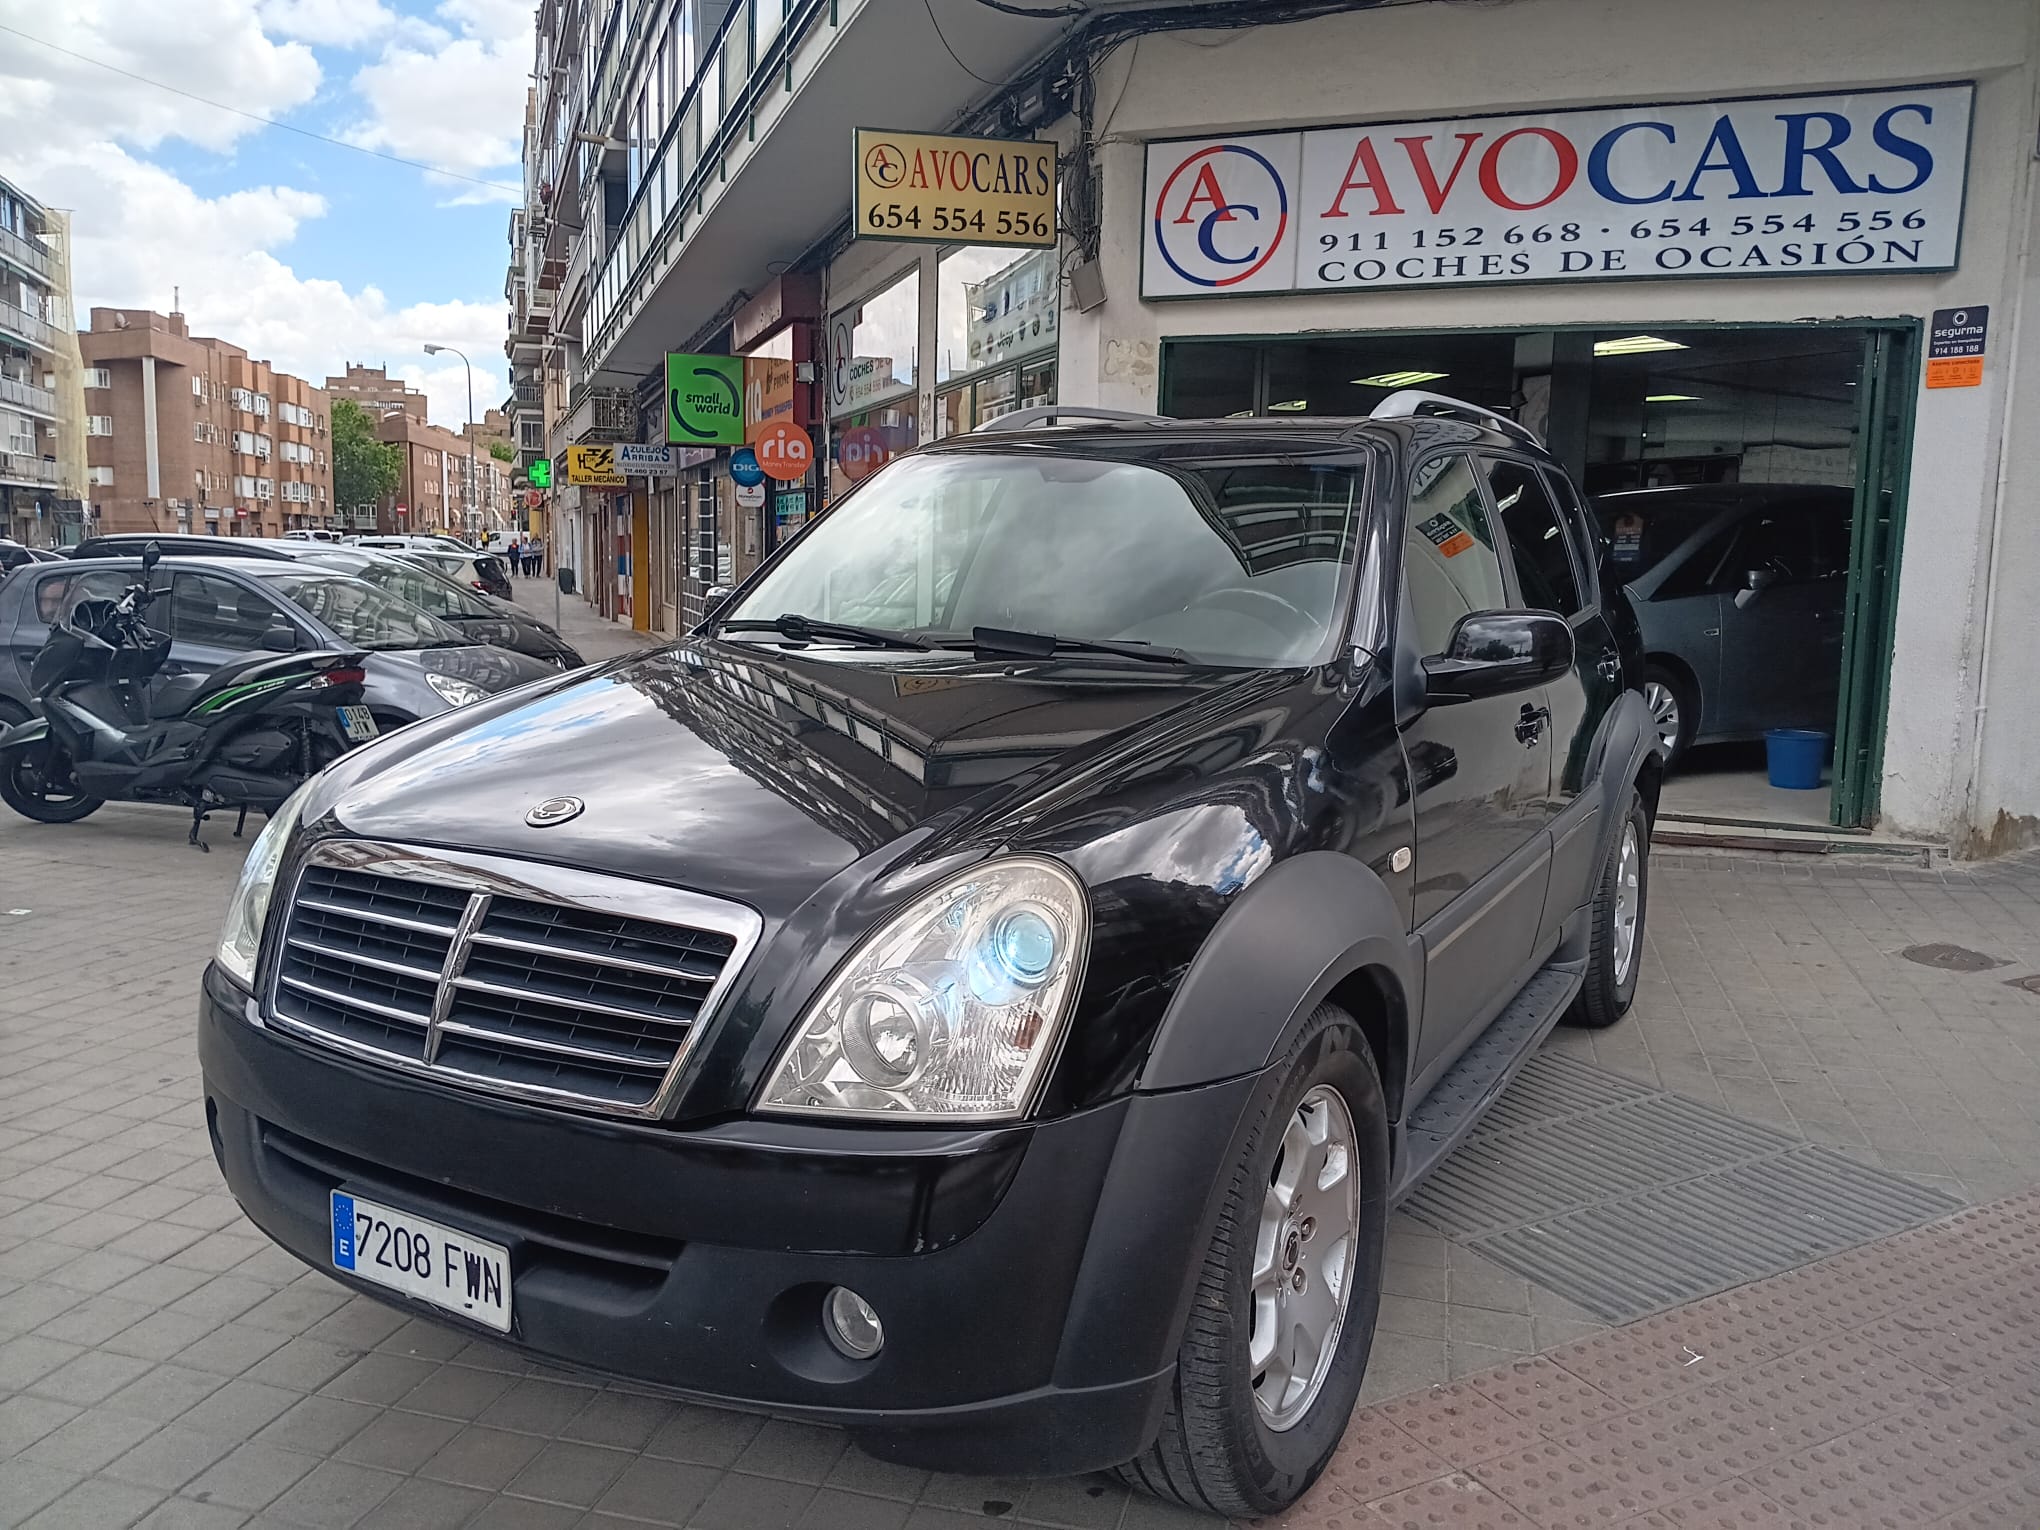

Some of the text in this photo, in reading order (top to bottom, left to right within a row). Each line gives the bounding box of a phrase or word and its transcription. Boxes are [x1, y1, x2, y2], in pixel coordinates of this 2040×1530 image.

[909, 147, 1049, 196] AVOCARS
[1320, 104, 1934, 218] AVOCARS
[868, 203, 1048, 237] 654 554 556
[1319, 209, 1926, 253] 911 152 668 654 554 556
[1318, 235, 1924, 282] COCHES DE OCASIÓN
[1934, 326, 1984, 338] segurma
[1934, 345, 1979, 355] 914 188 188
[849, 359, 874, 381] COCHES
[686, 392, 720, 405] small
[695, 403, 730, 415] world
[762, 429, 806, 459] ria
[572, 475, 592, 483] TALLER
[340, 1239, 349, 1256] E
[356, 1213, 502, 1308] 7208 FWN
